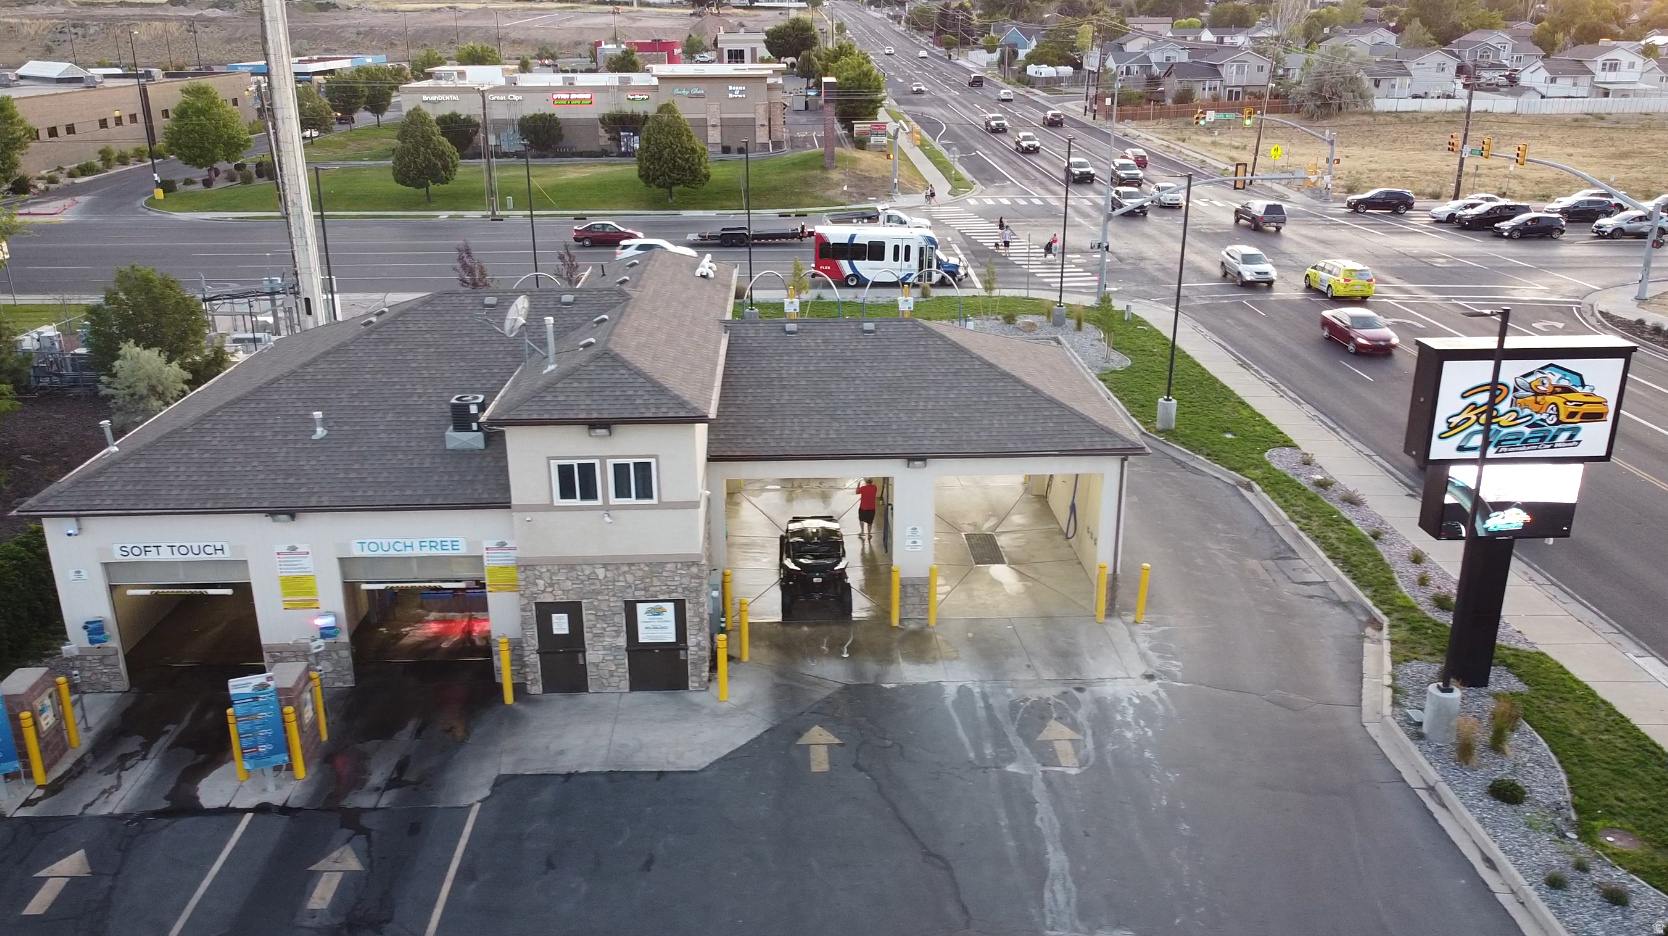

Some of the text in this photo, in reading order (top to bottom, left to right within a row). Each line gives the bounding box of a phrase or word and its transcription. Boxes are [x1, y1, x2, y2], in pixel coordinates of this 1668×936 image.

[508, 94, 523, 102] Clips
[1438, 381, 1532, 438] Bee
[119, 544, 225, 557] SOFT TOUCH
[357, 539, 460, 553] TOUCH FREE
